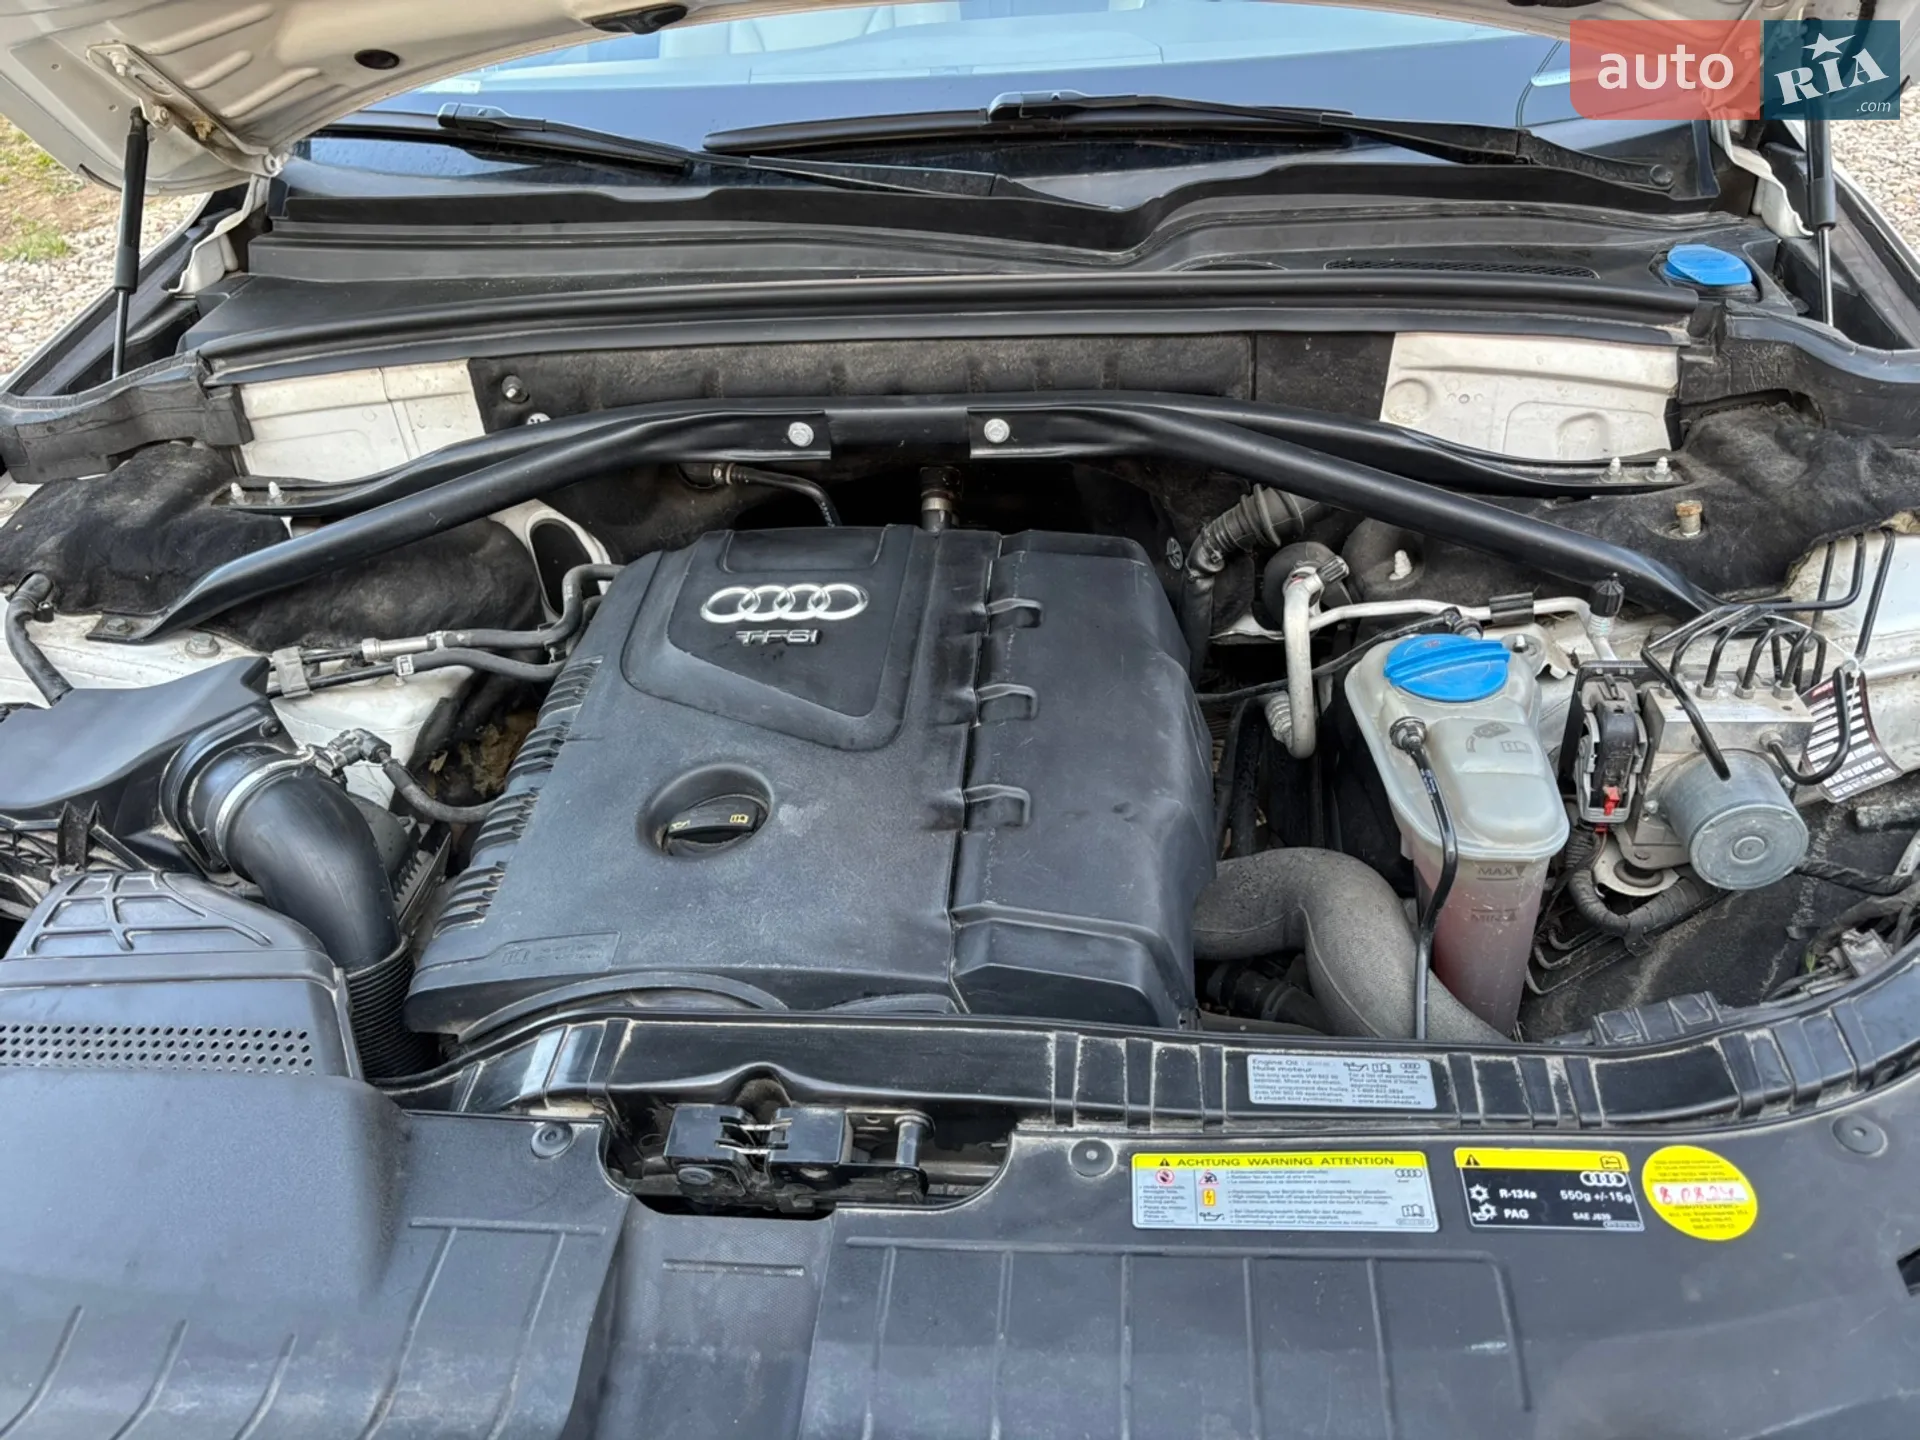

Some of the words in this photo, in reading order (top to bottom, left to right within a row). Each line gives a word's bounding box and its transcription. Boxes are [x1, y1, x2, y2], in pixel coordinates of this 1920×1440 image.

[1479, 866, 1513, 877] MAX
[1177, 1158, 1240, 1167] ACHTUNG
[1248, 1157, 1313, 1166] WARNING
[1320, 1156, 1394, 1166] ATTENTION
[1499, 1189, 1537, 1200] R-134a
[1560, 1190, 1591, 1203] 550g
[1503, 1208, 1529, 1219] PAG
